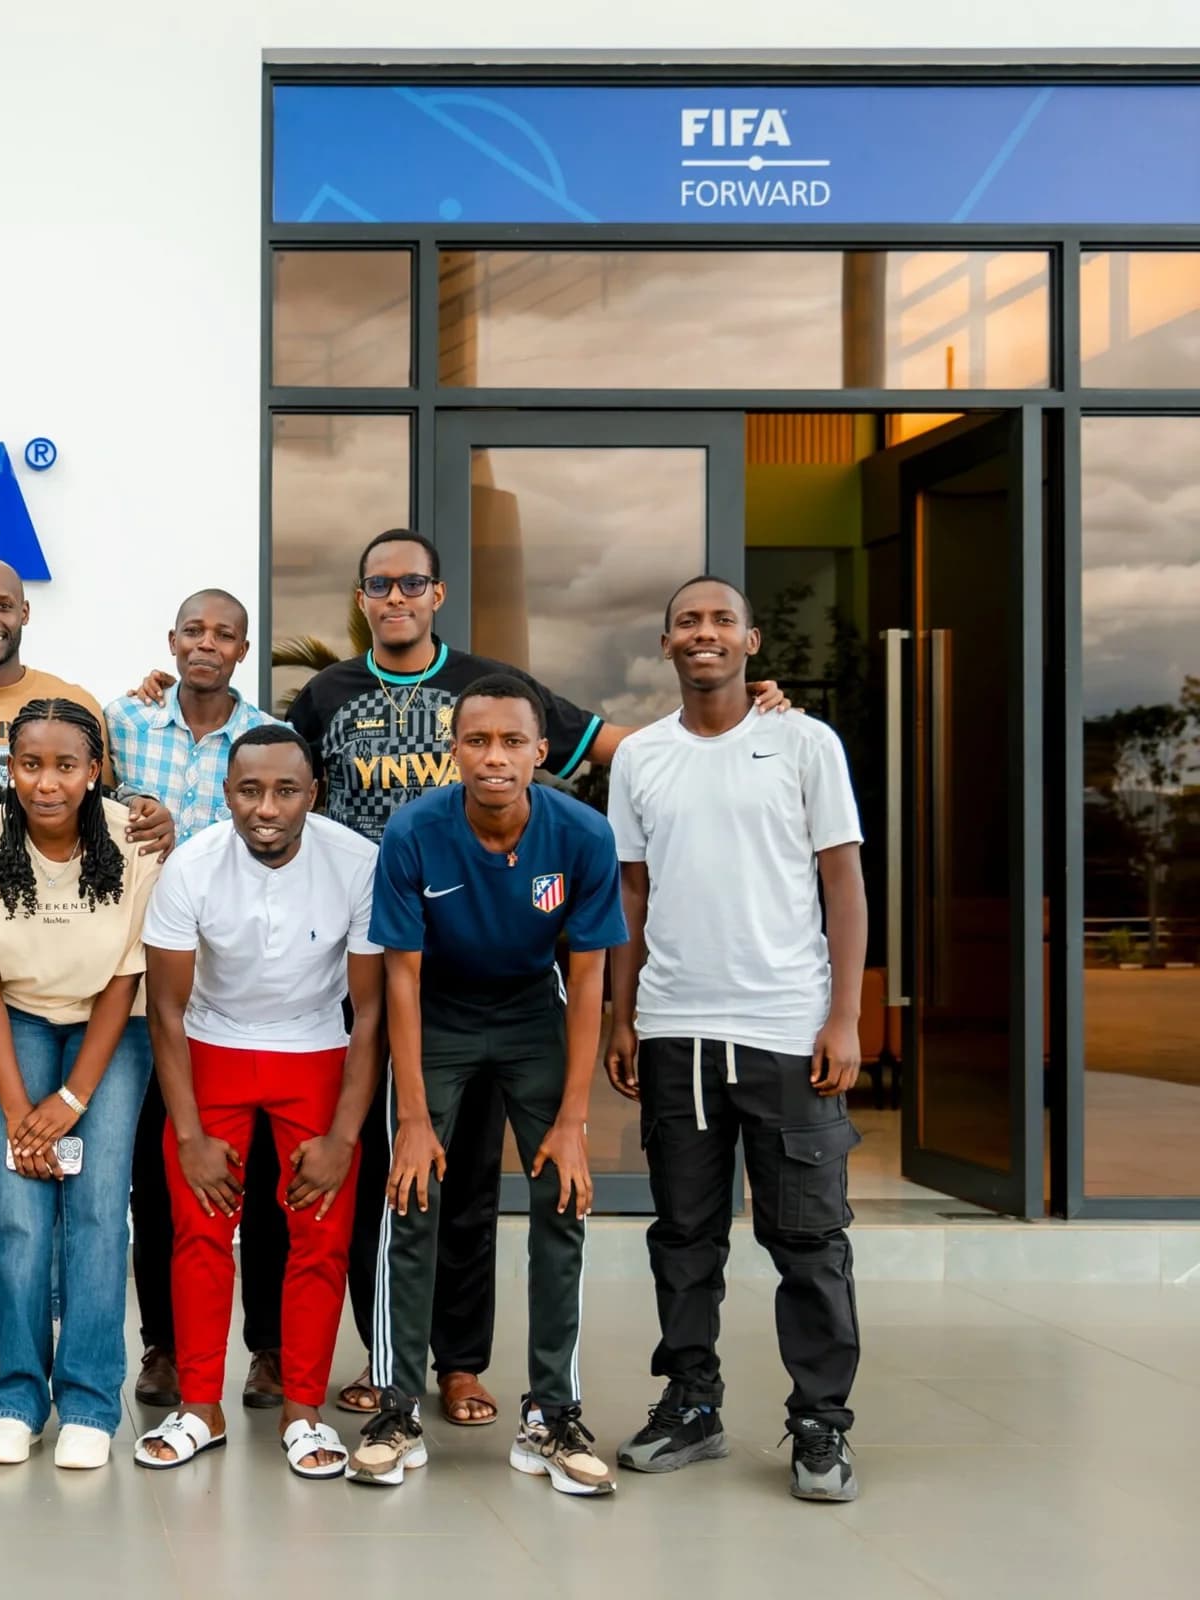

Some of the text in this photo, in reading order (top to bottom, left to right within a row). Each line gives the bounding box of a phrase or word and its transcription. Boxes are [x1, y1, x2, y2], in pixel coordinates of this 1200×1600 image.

[681, 108, 792, 146] FIFA
[681, 180, 831, 207] FORWARD
[354, 752, 461, 790] YNWA
[36, 902, 89, 911] EEKEND
